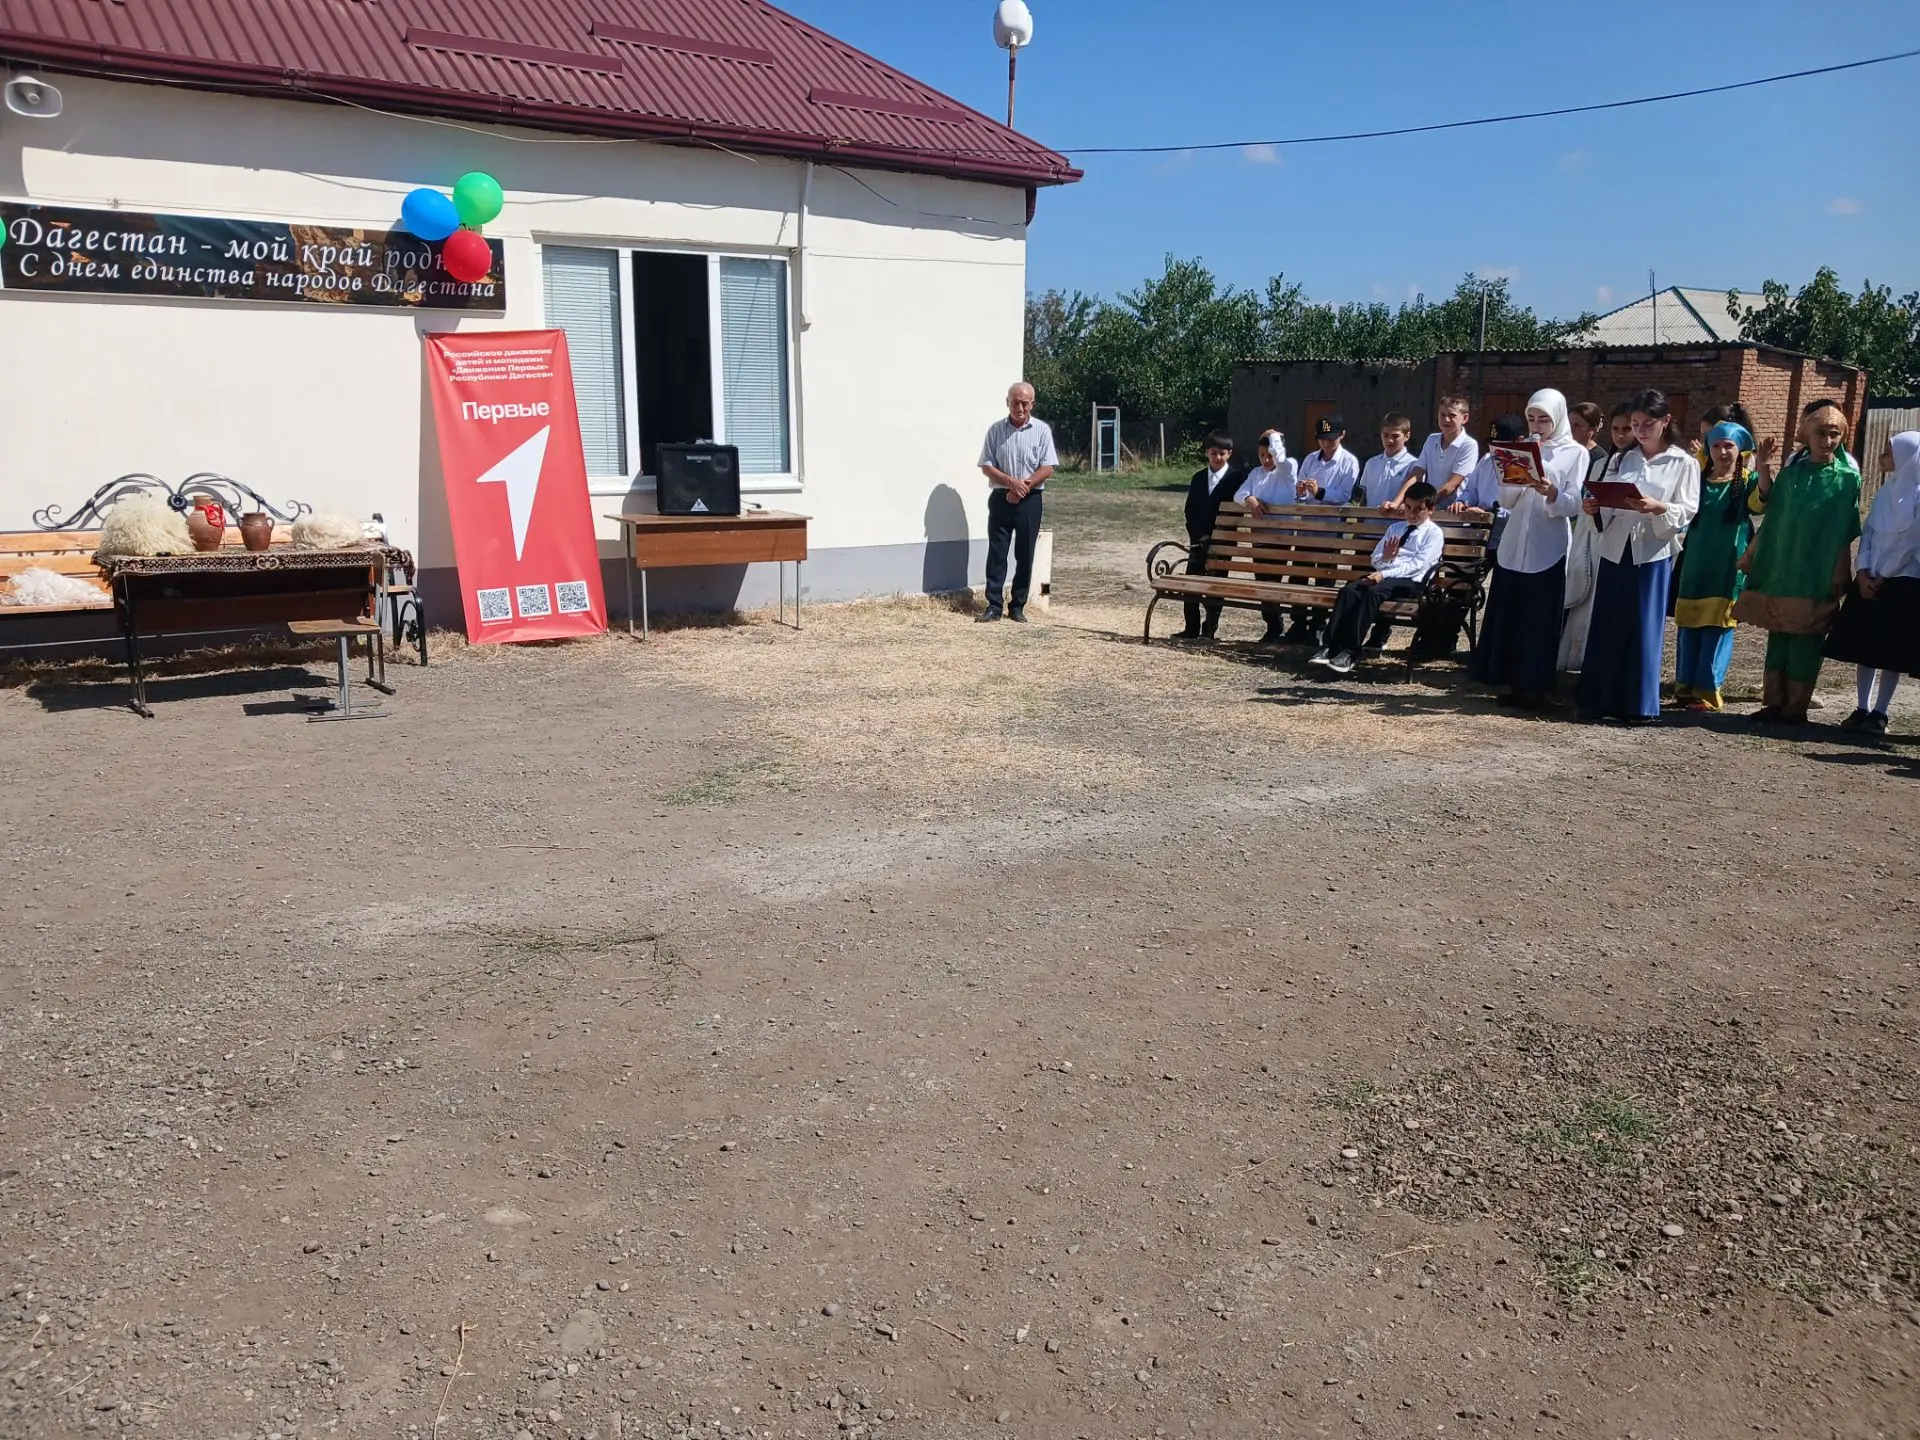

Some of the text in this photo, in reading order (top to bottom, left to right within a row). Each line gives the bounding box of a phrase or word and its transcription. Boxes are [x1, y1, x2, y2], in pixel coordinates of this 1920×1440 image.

[10, 217, 188, 255] Дагестан
[224, 236, 289, 261] мой
[301, 241, 373, 273] край
[385, 241, 492, 275] родн
[20, 251, 495, 297] С днем единства народов Дагестана
[443, 348, 552, 358] Российское движение
[461, 401, 550, 424] Первые
